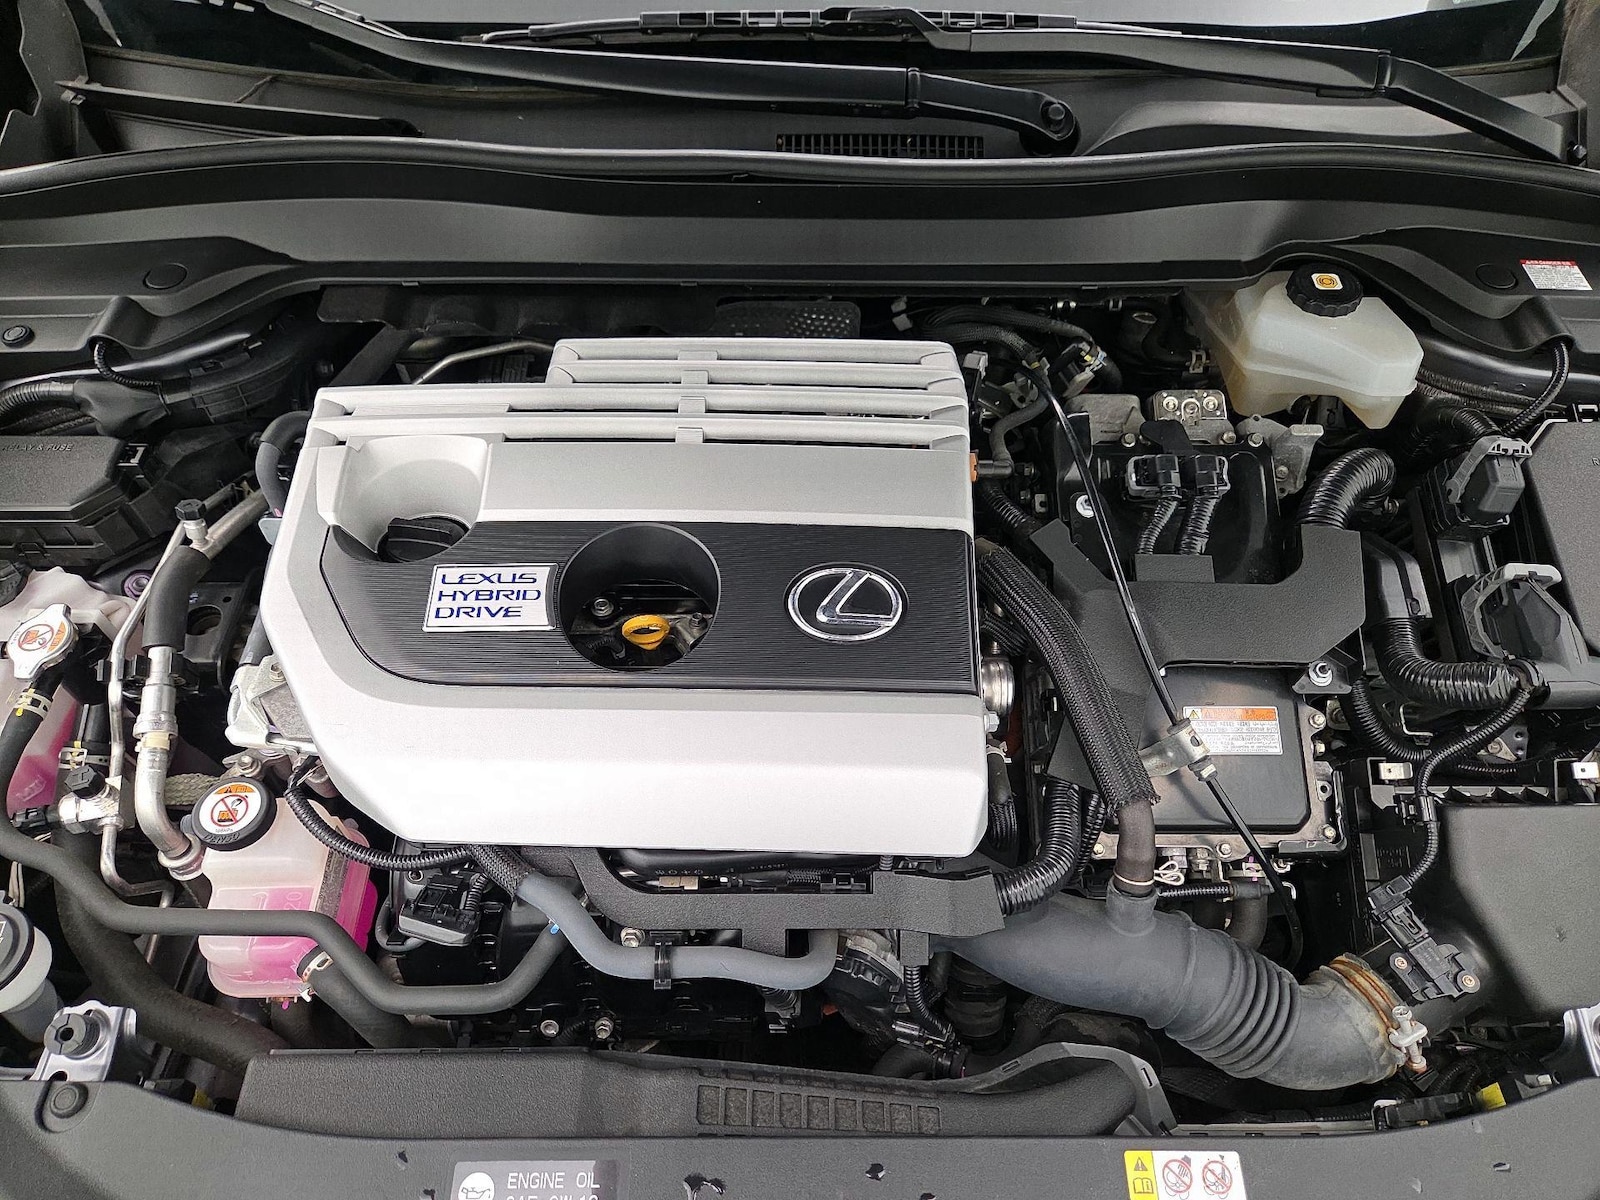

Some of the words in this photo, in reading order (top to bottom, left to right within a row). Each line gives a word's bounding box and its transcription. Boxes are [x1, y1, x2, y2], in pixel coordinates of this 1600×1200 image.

[3, 443, 34, 451] RELAY
[36, 443, 43, 451] &
[46, 443, 74, 452] FUSE
[441, 573, 537, 584] LEXUS
[438, 590, 541, 601] HYBRID
[434, 606, 523, 619] DRIVE
[204, 831, 241, 844] DENSO
[507, 1172, 566, 1189] ENGINE
[576, 1172, 600, 1188] OIL
